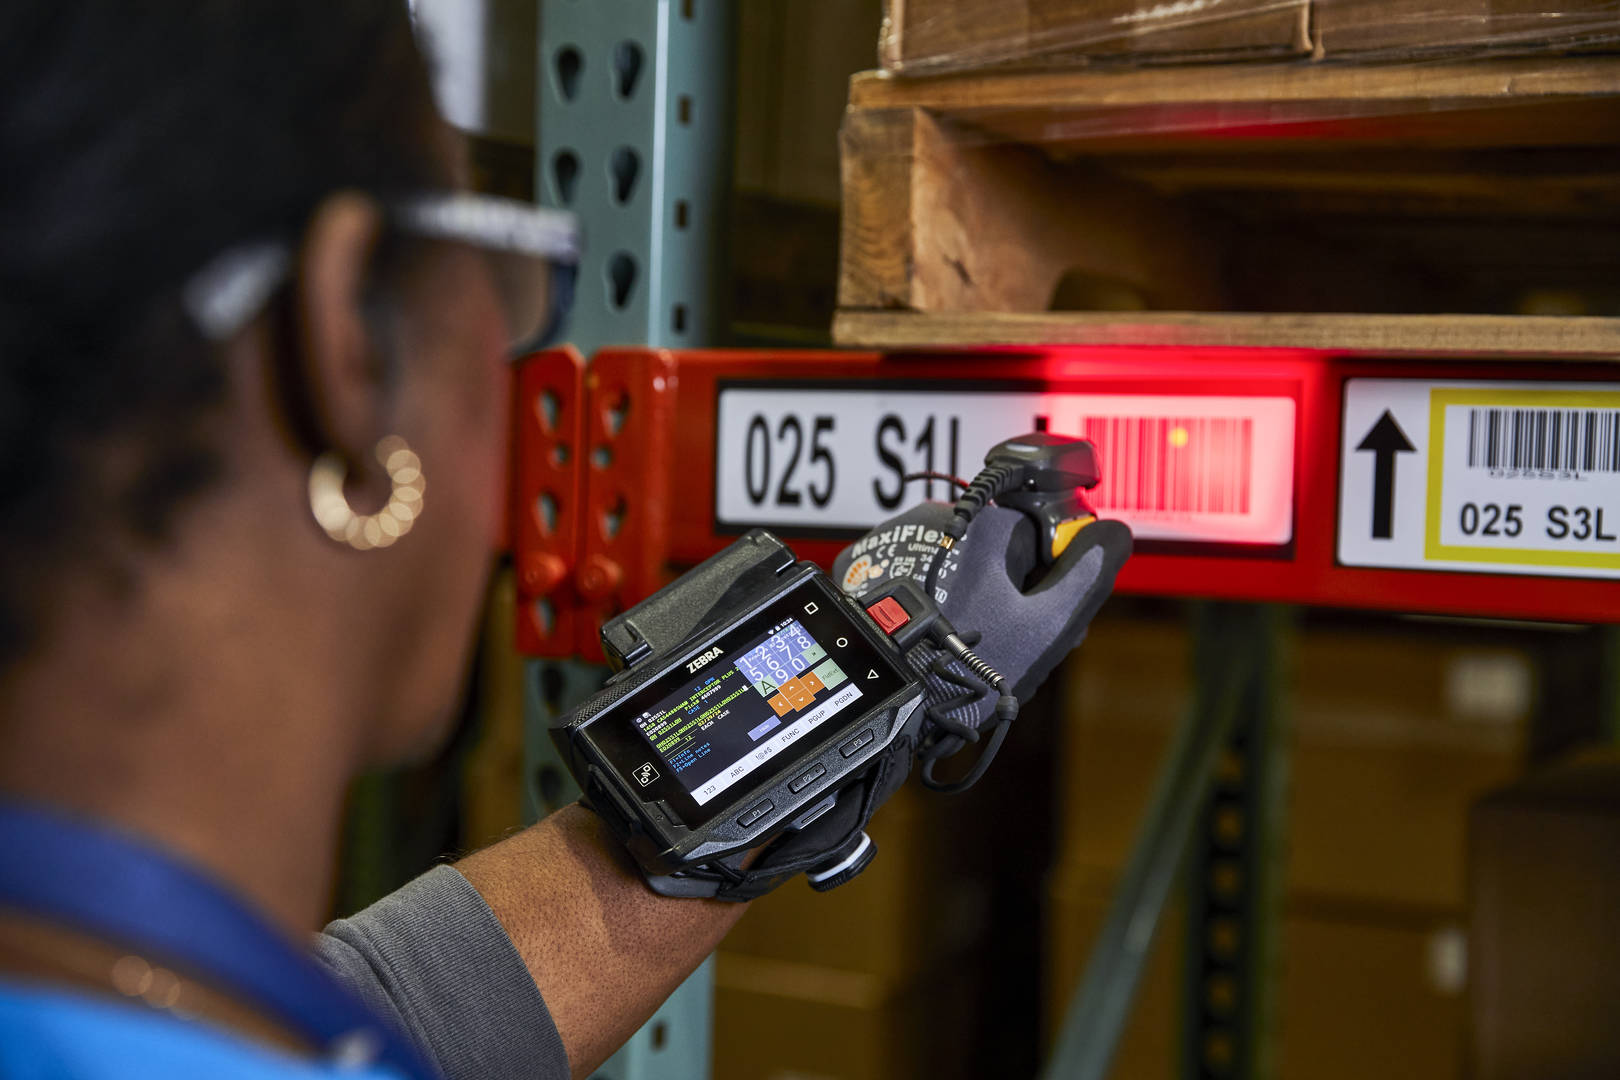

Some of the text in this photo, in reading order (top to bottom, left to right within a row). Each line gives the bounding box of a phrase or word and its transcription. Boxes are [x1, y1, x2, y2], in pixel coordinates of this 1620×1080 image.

[746, 412, 836, 508] 025
[1460, 502, 1617, 542] 025 S3L
[686, 646, 724, 674] ZEBRA
[740, 657, 752, 669] 1
[756, 646, 768, 660] 2
[771, 636, 785, 649] 3
[790, 624, 801, 637] 4
[750, 668, 763, 681] 5
[766, 657, 779, 670] 6
[779, 645, 792, 660] 7
[797, 636, 811, 649] 8
[762, 658, 805, 694] A 9 0
[688, 705, 701, 715] CASE
[701, 721, 714, 730] EACH
[717, 710, 730, 719] CASE
[703, 785, 717, 796] 123
[730, 765, 745, 779] ABC
[781, 727, 800, 743] FUNC
[807, 709, 826, 726] PGUP
[834, 691, 853, 706] PGDN
[853, 738, 862, 747] P3
[803, 774, 812, 782] P2
[752, 808, 761, 817] P1
